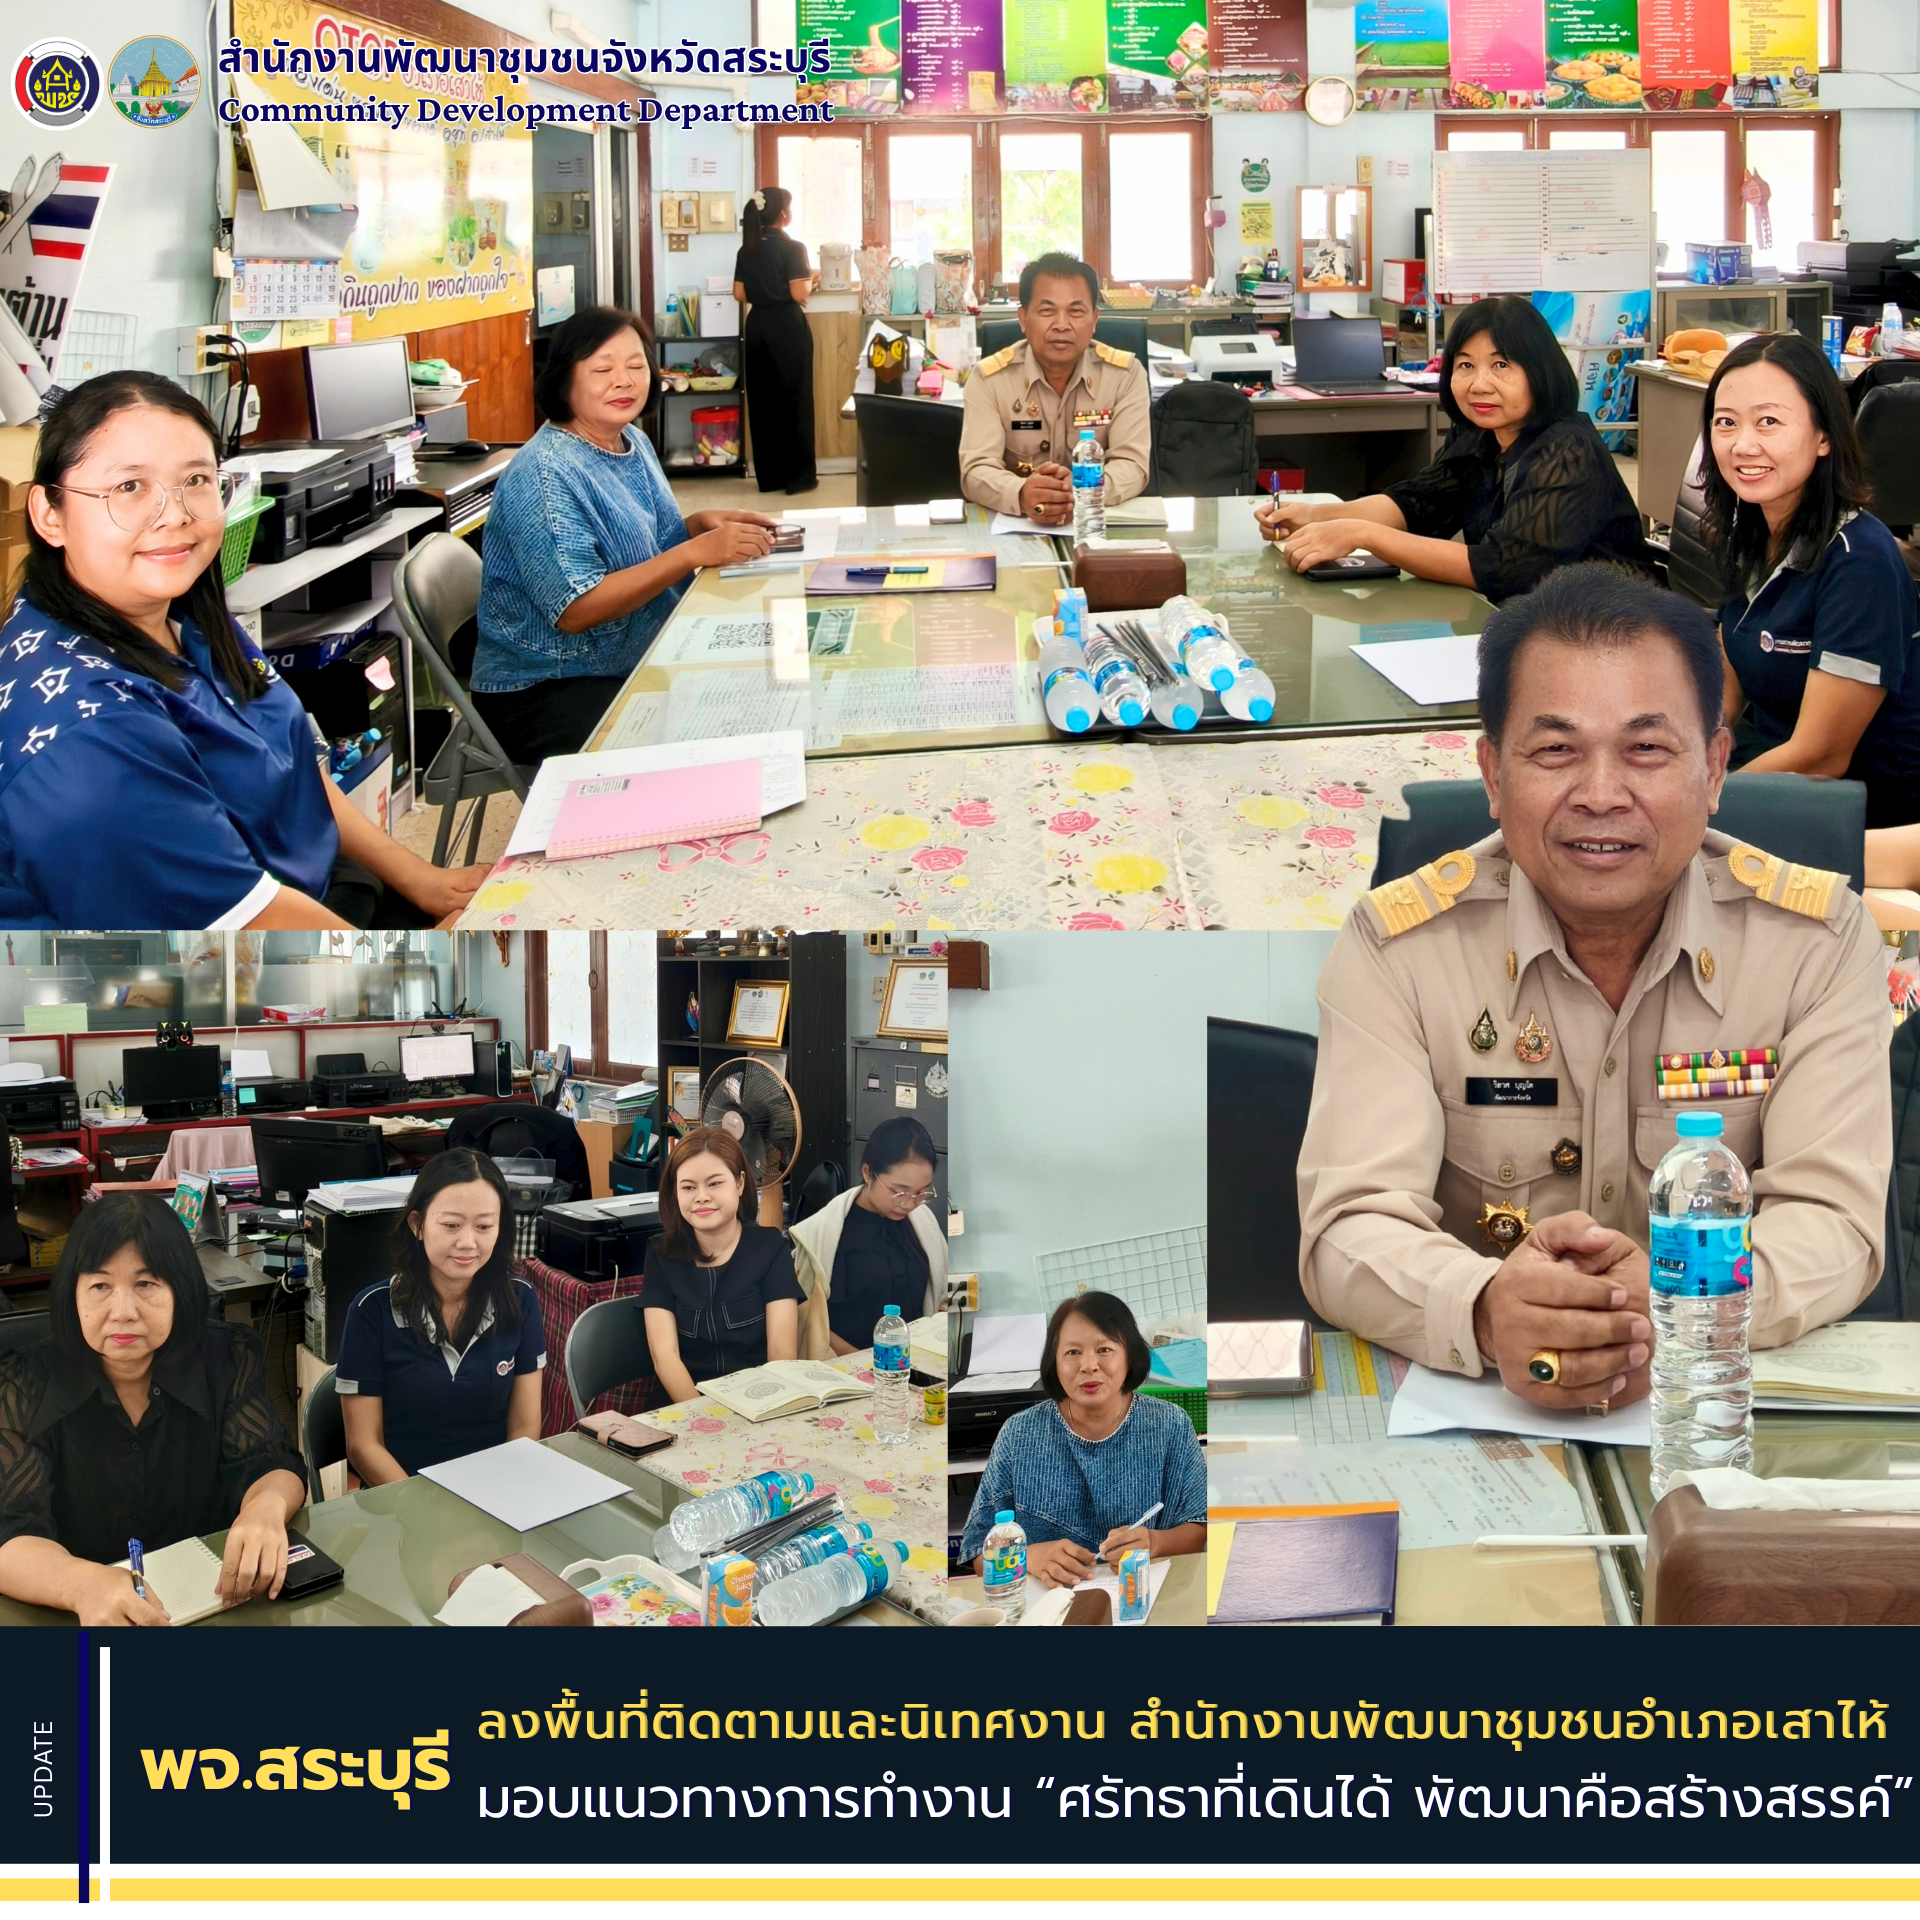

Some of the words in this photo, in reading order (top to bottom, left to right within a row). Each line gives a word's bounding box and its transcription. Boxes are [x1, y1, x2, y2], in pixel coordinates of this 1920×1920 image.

[235, 278, 241, 289] 9
[249, 306, 257, 314] 27
[263, 306, 271, 314] 28
[276, 306, 284, 314] 29
[290, 306, 297, 314] 30
[343, 1127, 371, 1138] acer
